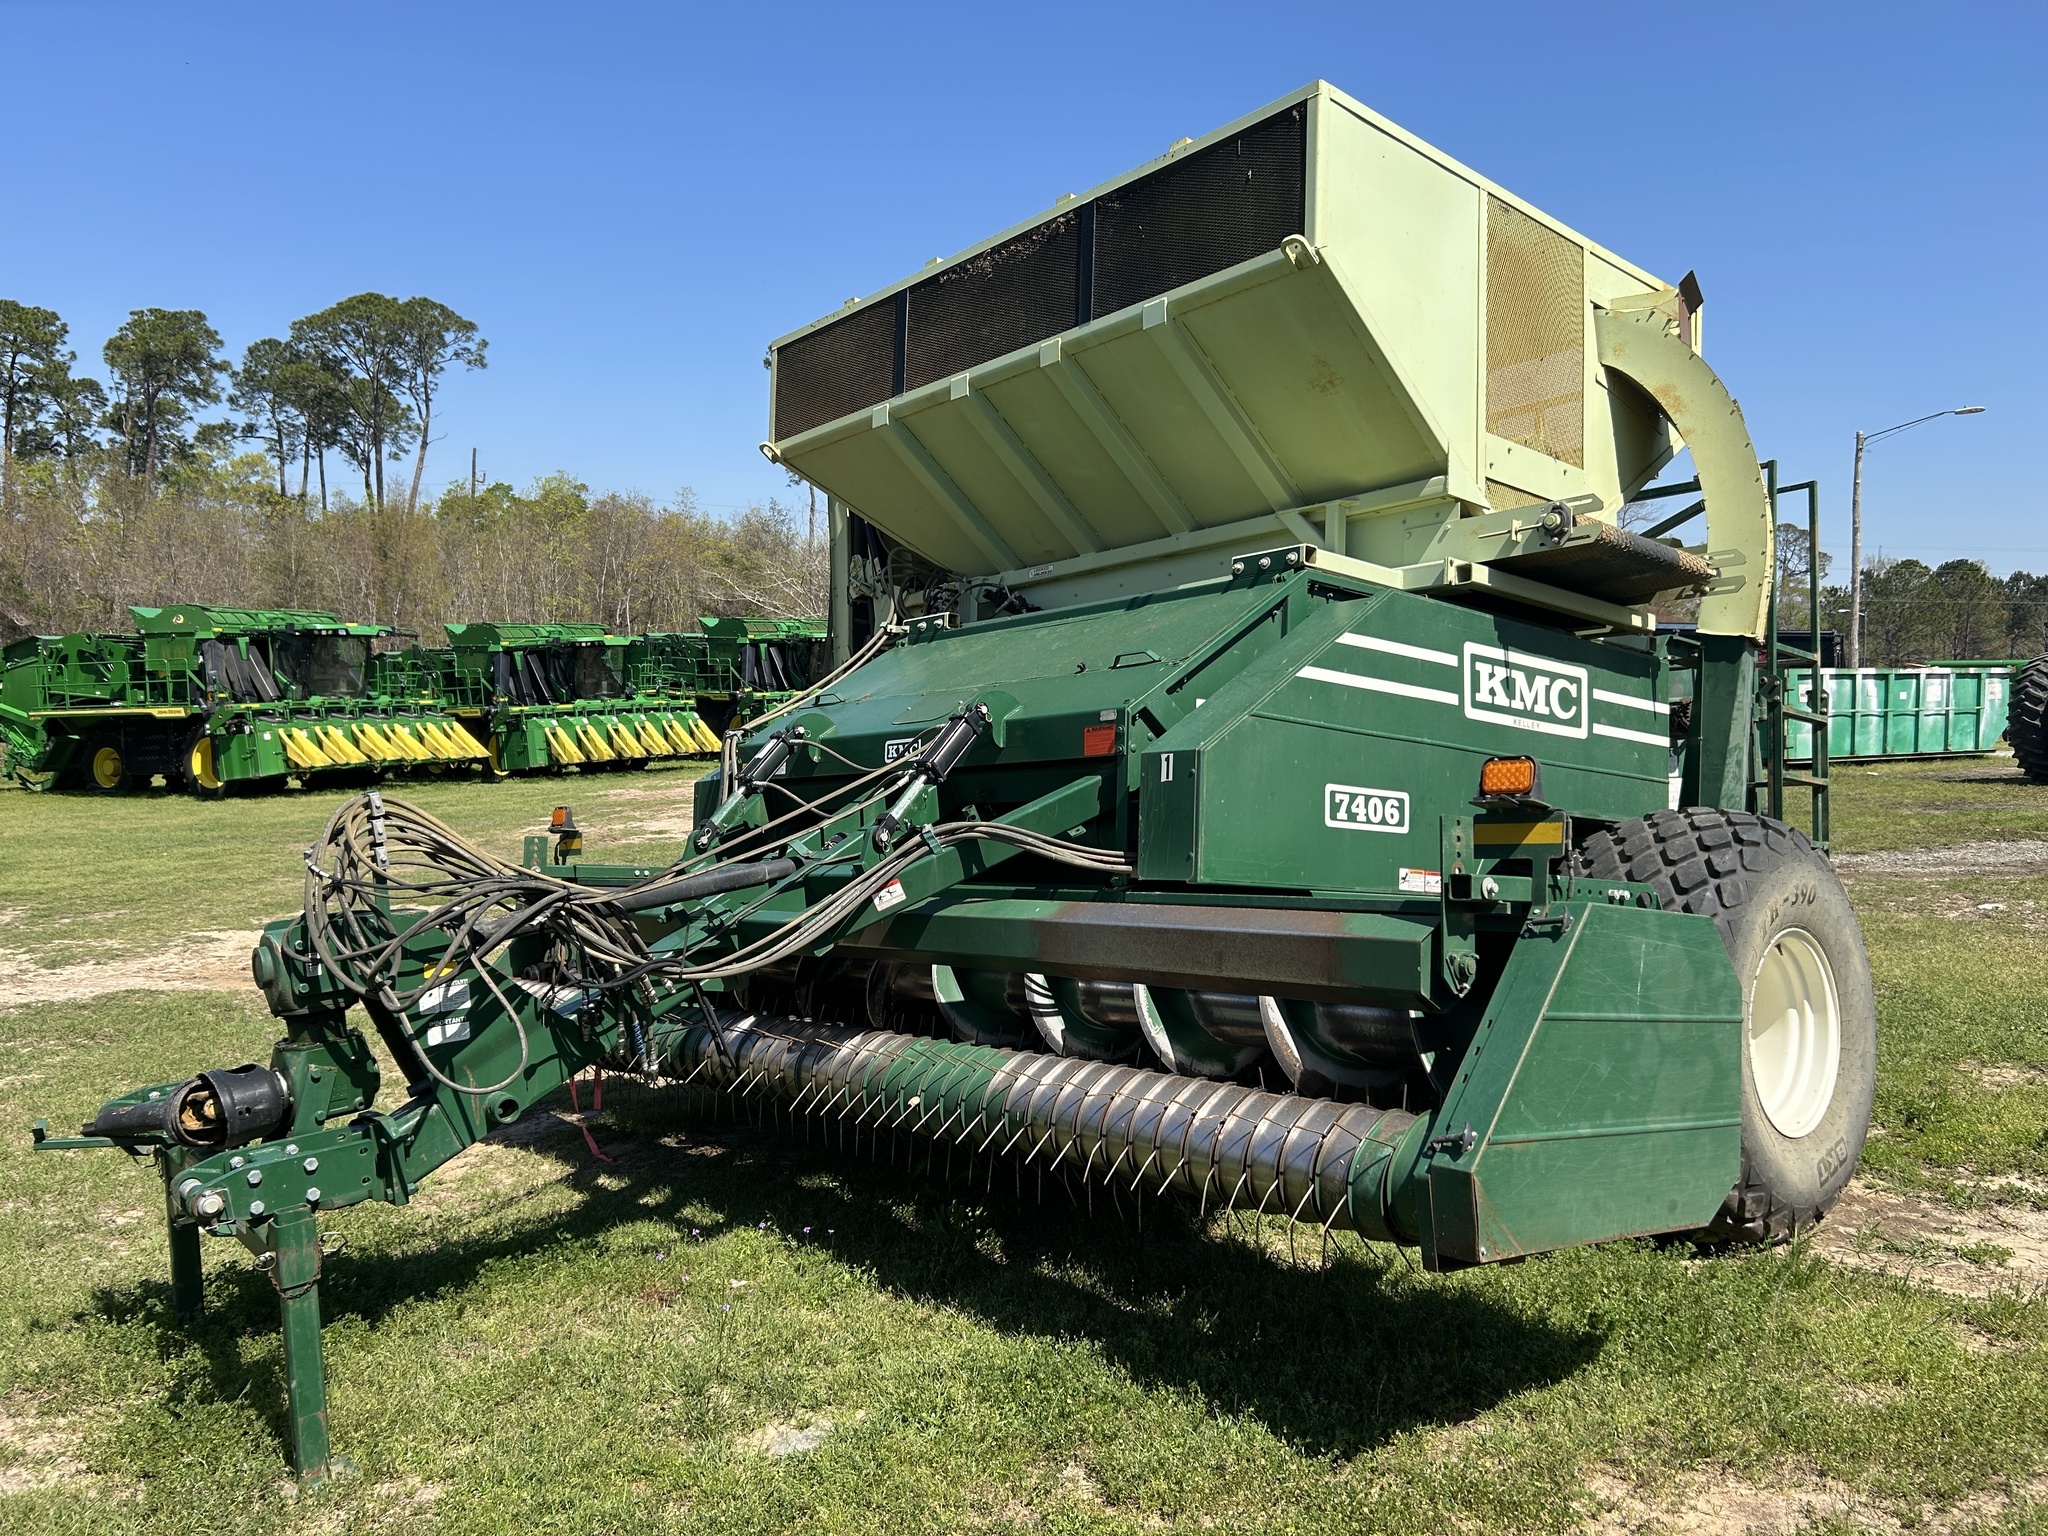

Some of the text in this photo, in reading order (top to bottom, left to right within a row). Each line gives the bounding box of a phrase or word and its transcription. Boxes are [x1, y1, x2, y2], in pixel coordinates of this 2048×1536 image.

[1475, 661, 1578, 720] KMC
[1513, 718, 1541, 729] KELLEY
[1164, 754, 1171, 780] 1
[1335, 793, 1400, 825] 7406
[1816, 1136, 1848, 1189] BKT
